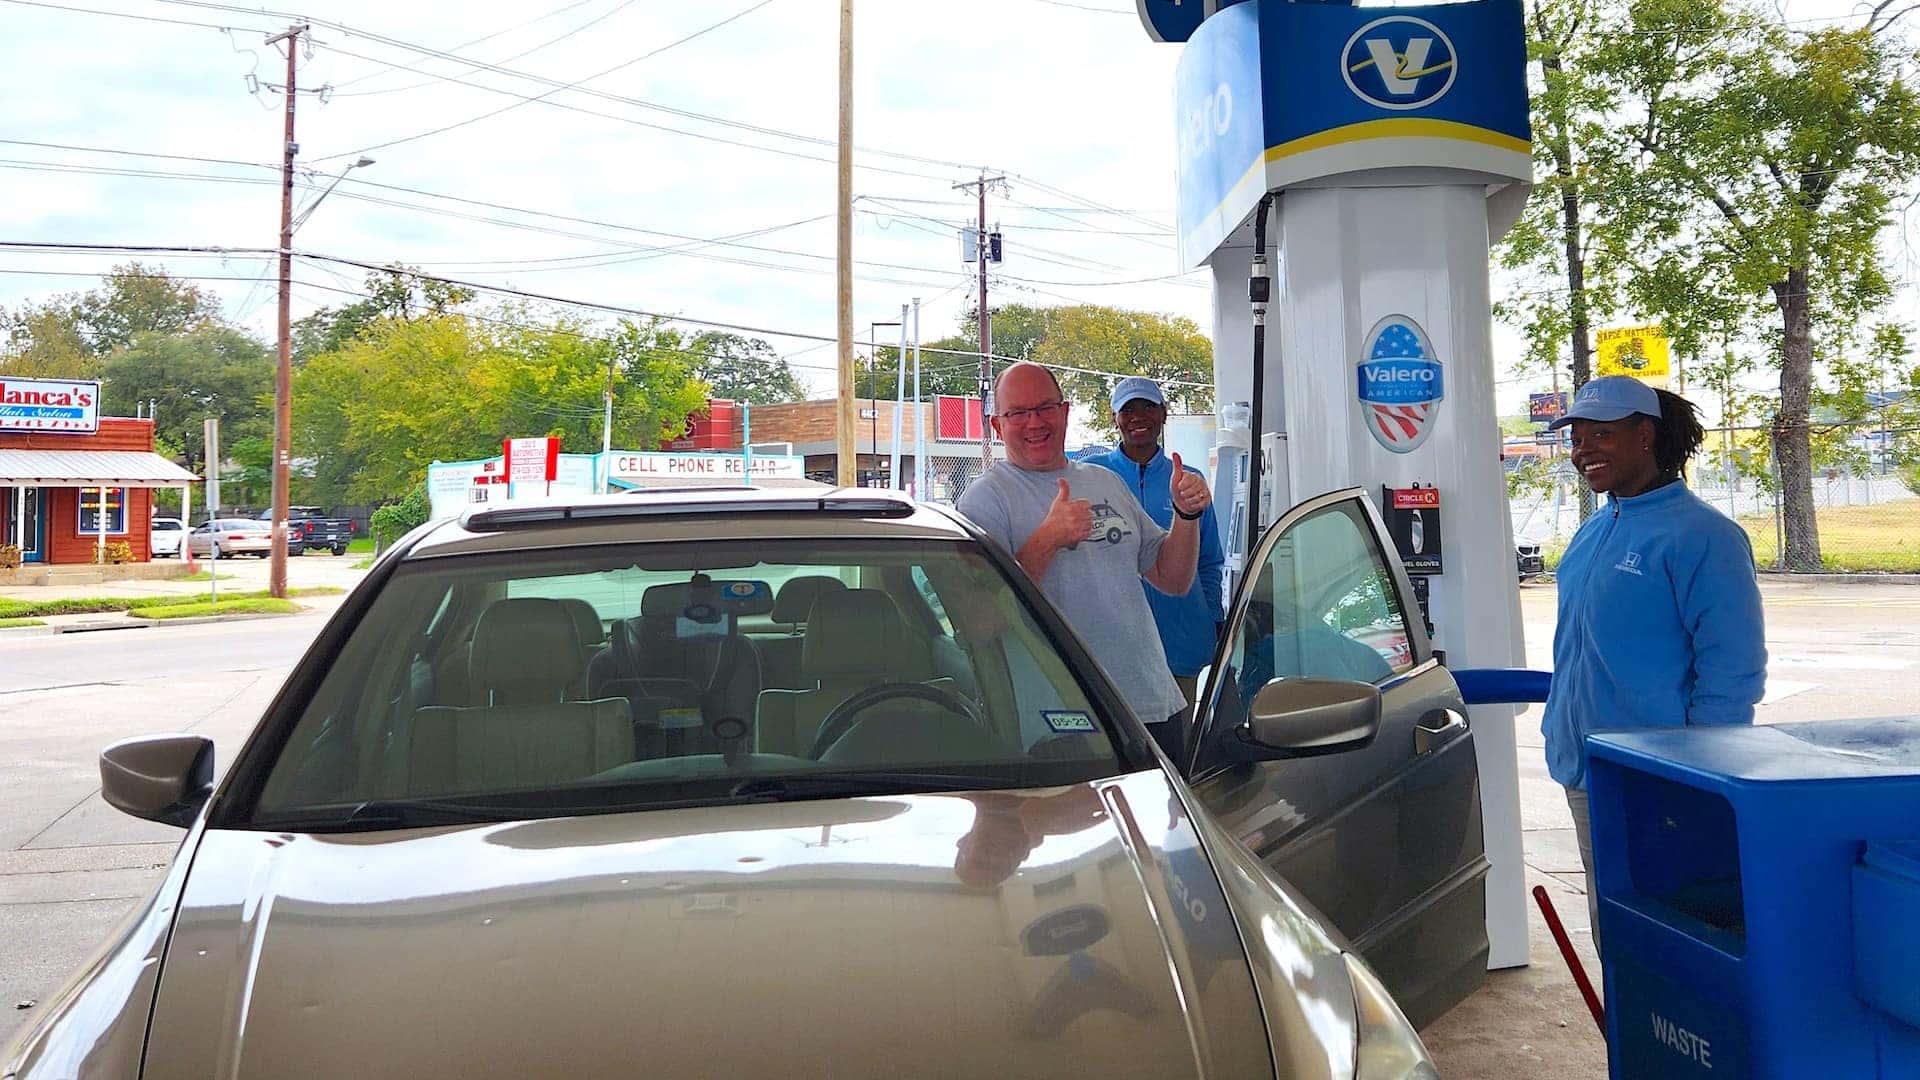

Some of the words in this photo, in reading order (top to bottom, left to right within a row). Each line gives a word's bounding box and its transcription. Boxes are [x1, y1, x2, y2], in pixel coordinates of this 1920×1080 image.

[1364, 366, 1435, 383] Valero
[618, 458, 657, 472] CELL
[669, 458, 714, 472] PHONE
[1398, 494, 1424, 502] CIRCLE
[1651, 1010, 1713, 1069] WASTE
